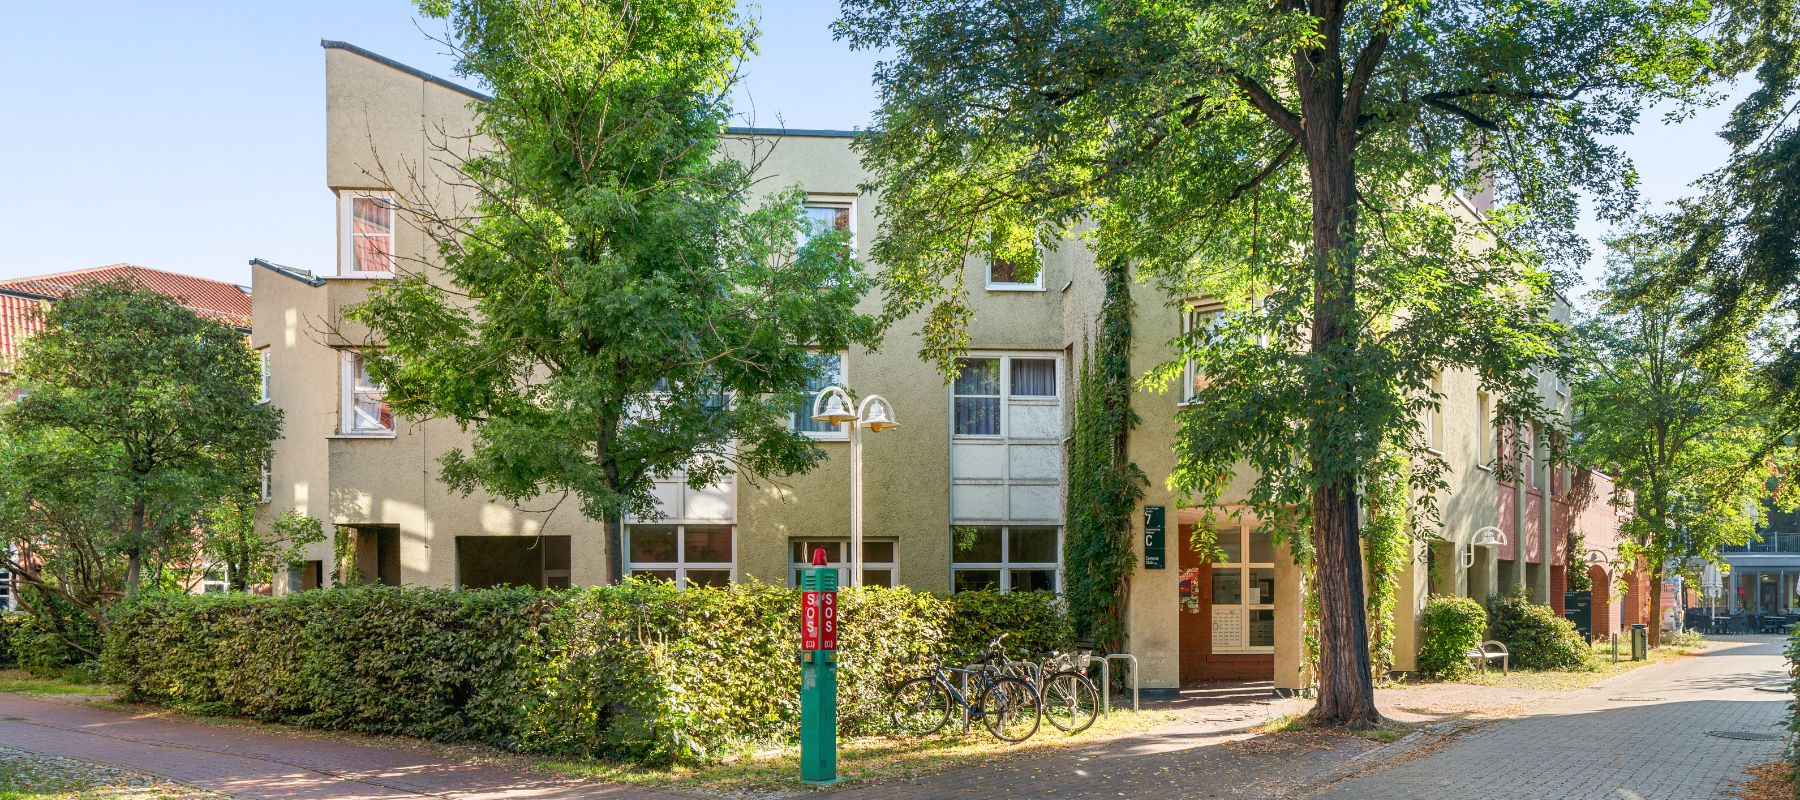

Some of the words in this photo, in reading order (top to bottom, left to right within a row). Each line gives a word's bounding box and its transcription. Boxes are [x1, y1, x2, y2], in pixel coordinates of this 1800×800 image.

[1145, 512, 1152, 525] 7
[1145, 534, 1152, 546] C
[807, 593, 815, 632] SOS
[825, 593, 833, 632] SOS
